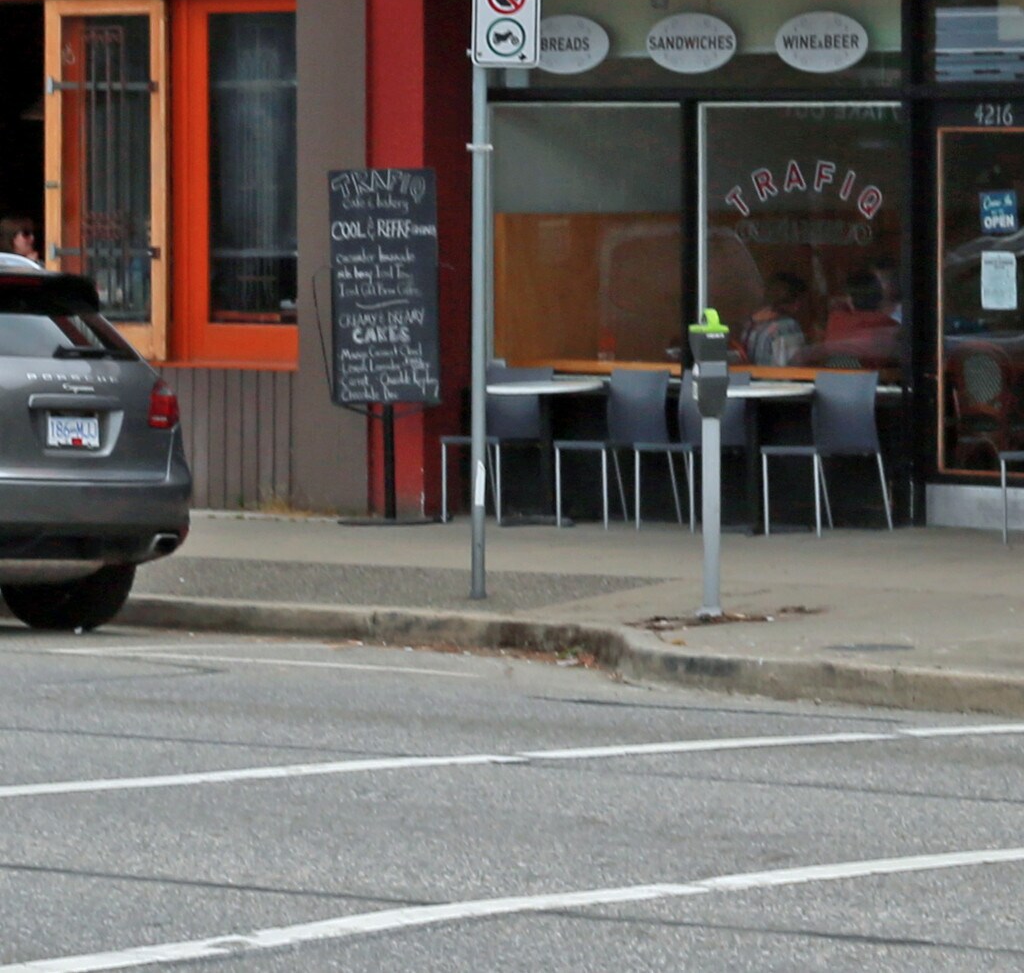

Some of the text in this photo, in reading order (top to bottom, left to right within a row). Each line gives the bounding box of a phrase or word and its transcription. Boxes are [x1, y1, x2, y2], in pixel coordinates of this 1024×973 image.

[540, 36, 590, 52] BREADS
[649, 35, 734, 51] SANDWICHES
[782, 34, 860, 50] WINE&BEER
[974, 103, 1014, 126] 4216
[725, 159, 884, 219] TRAFIQ
[984, 214, 1014, 229] OPEN
[331, 220, 366, 241] COOL
[352, 327, 411, 344] CAKES
